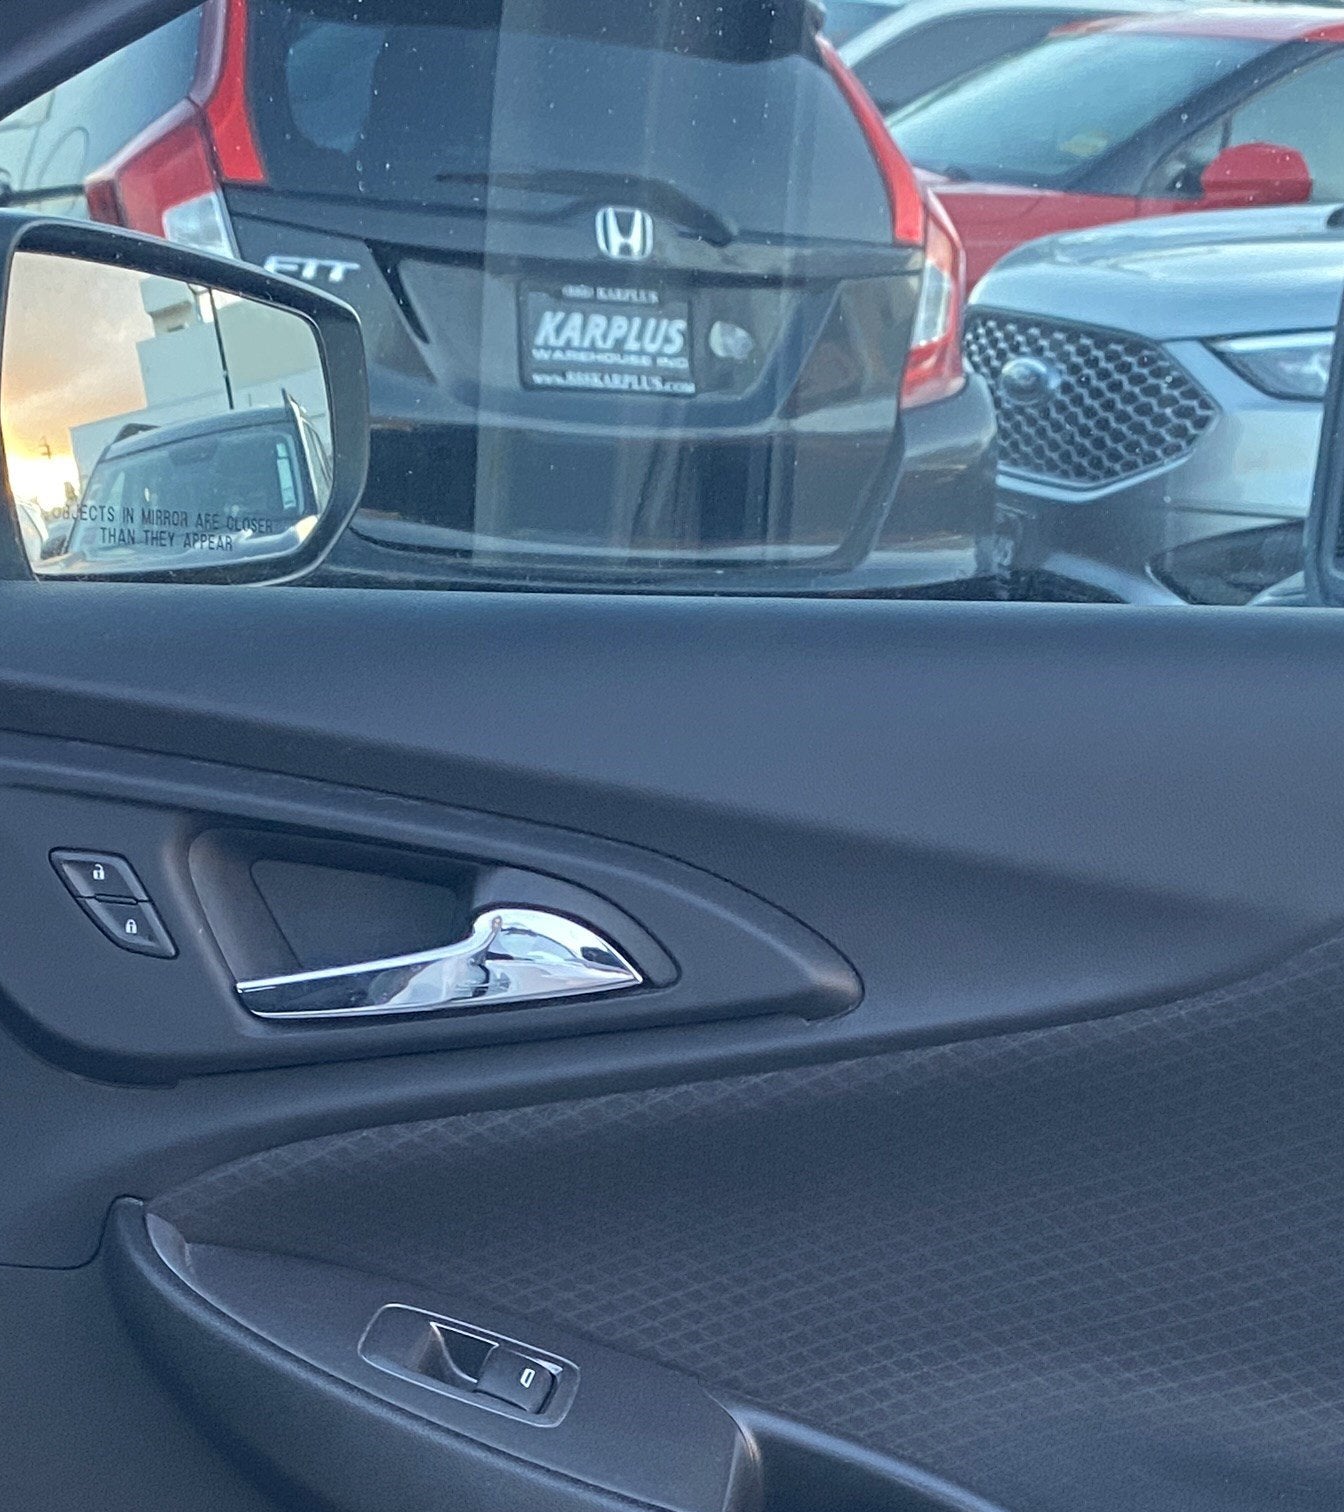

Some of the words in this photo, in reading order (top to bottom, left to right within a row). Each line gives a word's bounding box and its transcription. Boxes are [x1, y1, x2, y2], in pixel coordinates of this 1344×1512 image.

[533, 310, 688, 355] KARPLUS
[52, 503, 115, 522] OBJECTS
[122, 507, 135, 522] IN
[141, 509, 189, 528] MIRROR
[195, 513, 219, 531] ARE
[225, 514, 274, 534] CLOSER
[100, 526, 136, 545] THAN
[143, 530, 175, 547] THEY
[183, 532, 234, 552] APPEAR
